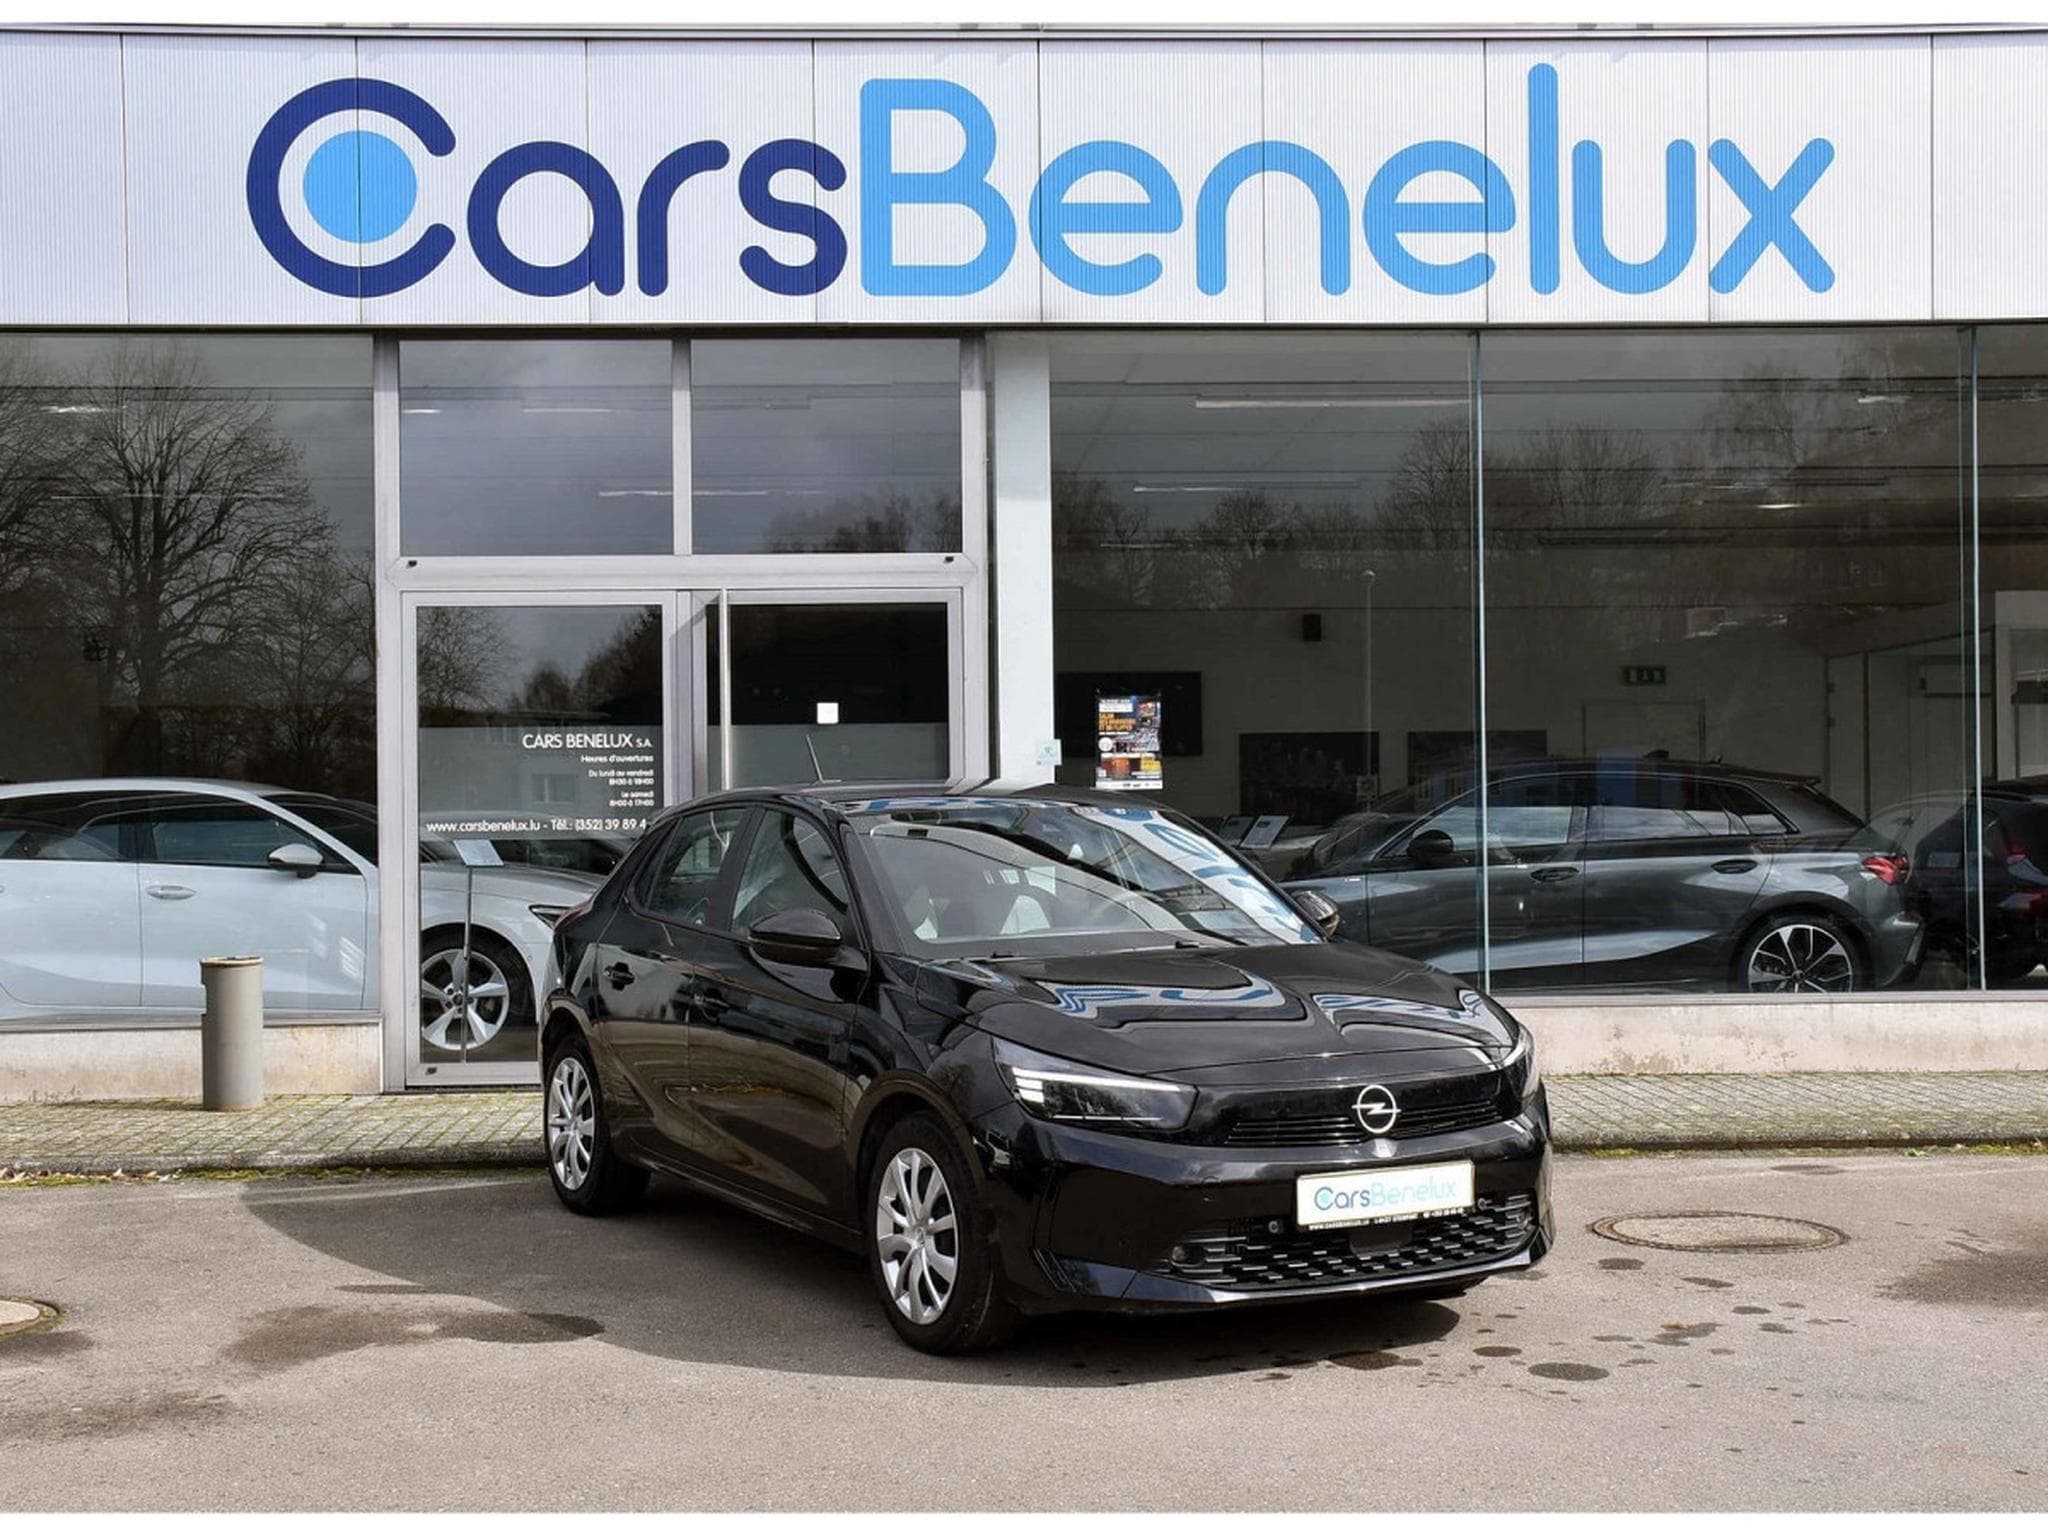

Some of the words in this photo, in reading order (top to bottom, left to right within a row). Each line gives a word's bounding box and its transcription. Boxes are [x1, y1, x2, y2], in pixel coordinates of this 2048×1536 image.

[246, 63, 1836, 298] CarsBenelux
[522, 733, 563, 749] CARS
[566, 733, 634, 749] BENELUX
[580, 754, 608, 763] Heures
[608, 754, 654, 763] d'ouvertures
[588, 769, 598, 778] Du
[599, 769, 615, 777] lundi
[626, 769, 654, 777] vendredi
[426, 819, 541, 833] www.carsbenelux.lu
[574, 817, 603, 832] (352)
[604, 818, 620, 831] 39
[622, 818, 637, 831] 89
[1314, 1175, 1457, 1211] CarsBenelux
